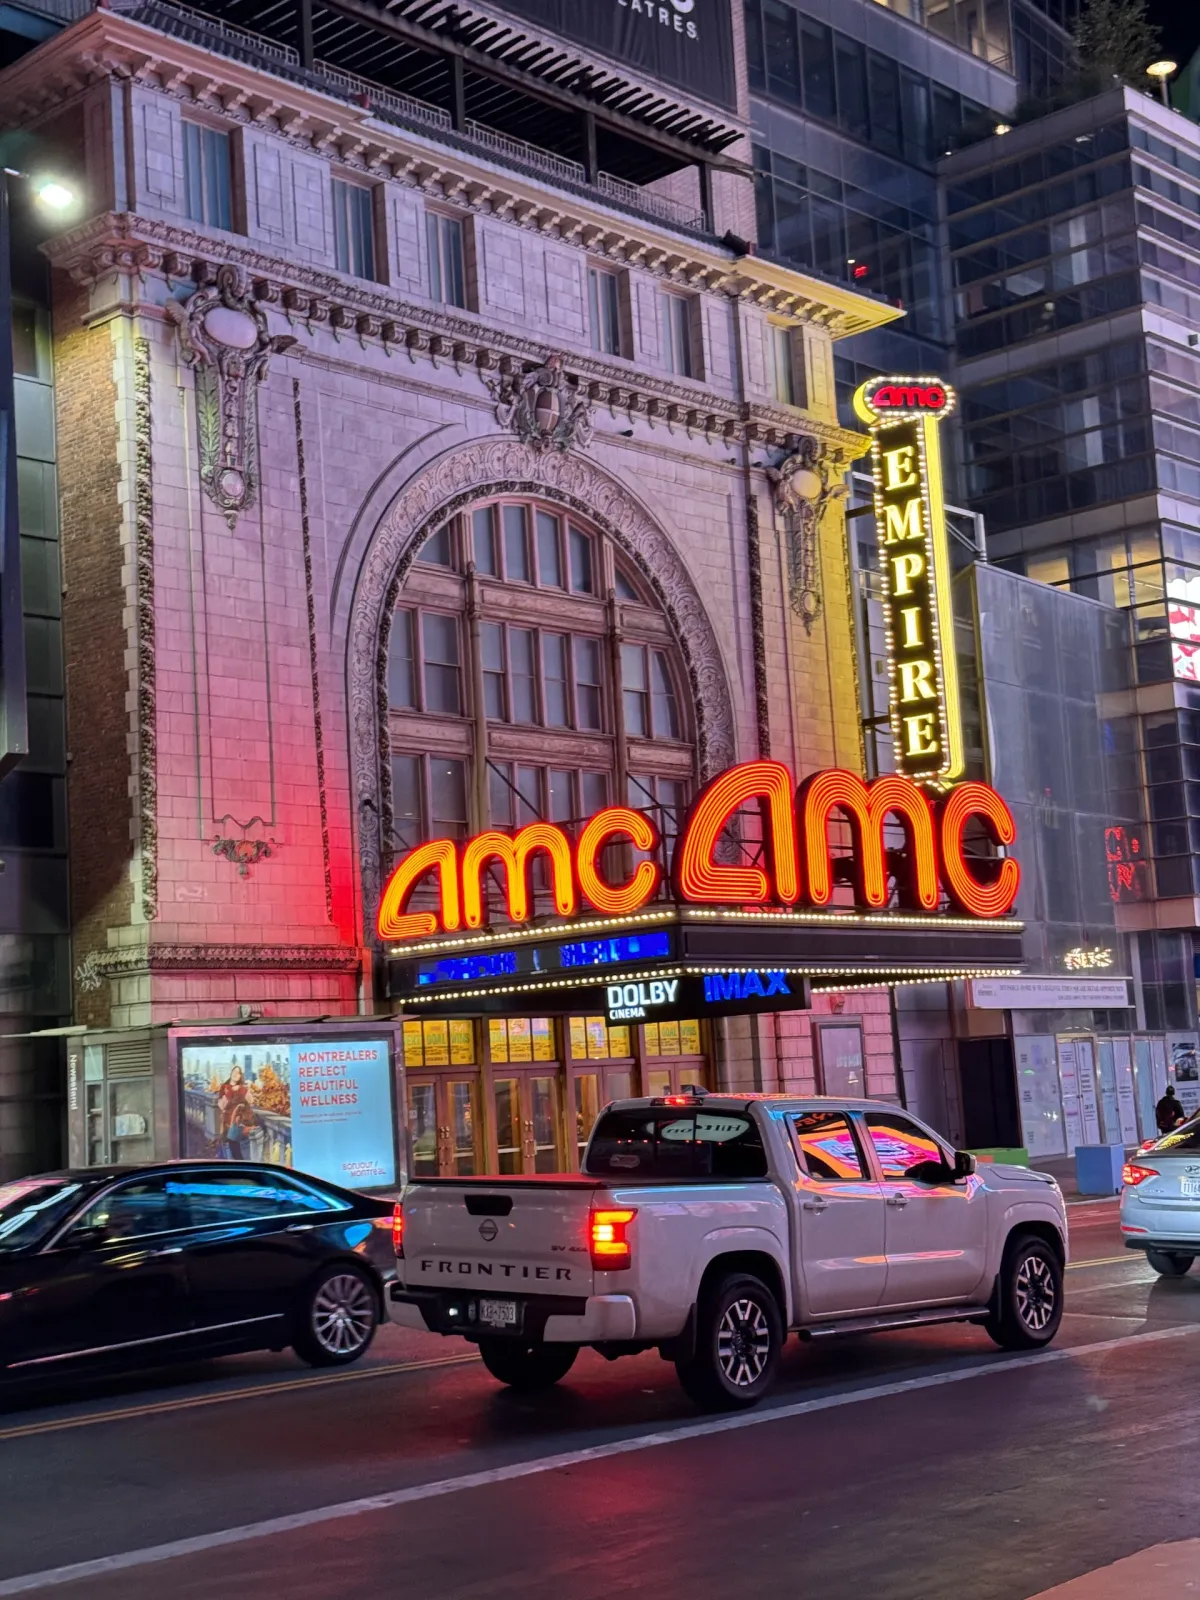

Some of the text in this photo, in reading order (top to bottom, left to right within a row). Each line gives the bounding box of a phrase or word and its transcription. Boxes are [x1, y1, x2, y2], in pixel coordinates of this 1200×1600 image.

[883, 445, 937, 757] EMPIRE
[704, 970, 791, 1003] IMAX
[607, 979, 679, 1009] DOLBY
[609, 1007, 646, 1020] CINEMA
[298, 1050, 378, 1063] MONTREALERS
[298, 1065, 347, 1078] REFLECT
[299, 1079, 358, 1092] BEAUTIFUL
[300, 1093, 358, 1106] WELLNESS
[421, 1259, 573, 1281] FRONTIER
